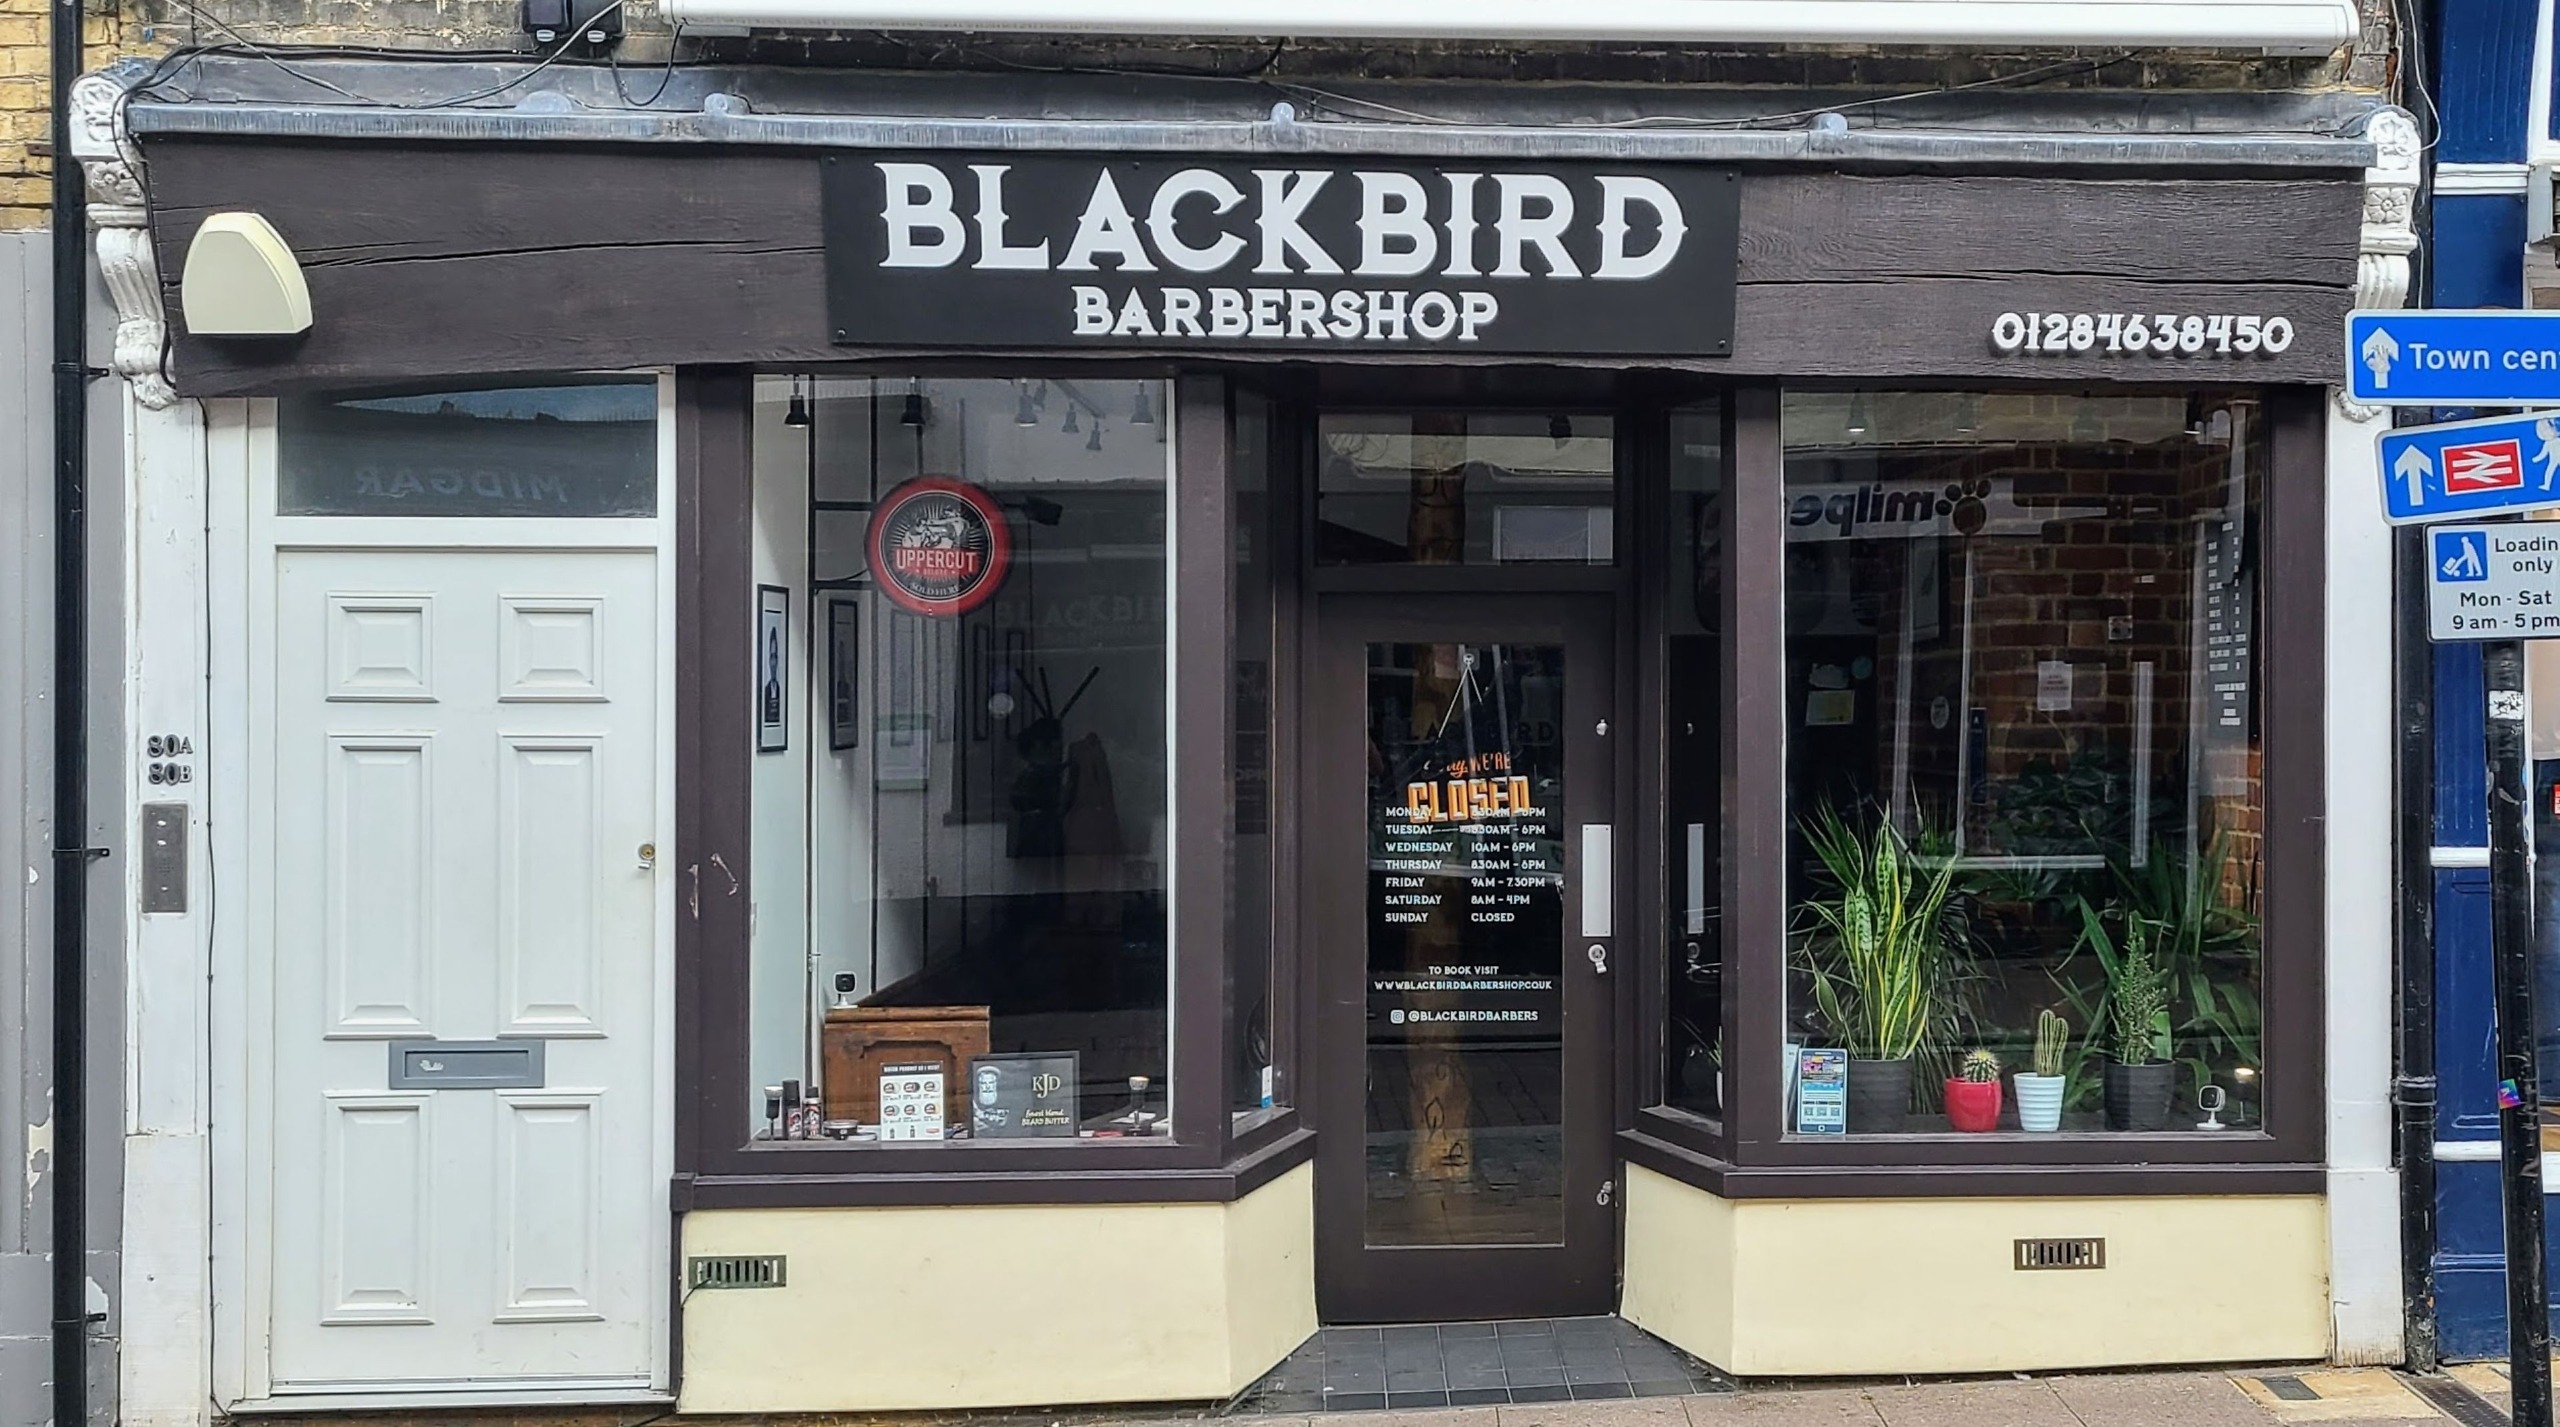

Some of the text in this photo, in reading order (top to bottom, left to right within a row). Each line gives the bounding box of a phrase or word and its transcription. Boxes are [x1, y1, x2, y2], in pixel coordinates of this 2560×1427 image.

[874, 162, 1689, 280] BLACKBIRD
[1071, 285, 1498, 341] BARBERSHOP
[1991, 312, 2294, 353] 01284638450
[2408, 343, 2560, 370] Town cen
[2495, 536, 2560, 553] Loadin
[896, 549, 977, 573] UPPERCUT
[2513, 557, 2552, 574] only
[2460, 592, 2501, 607] Mon
[2518, 590, 2552, 606] Sat
[2452, 615, 2464, 630] 9
[2469, 618, 2497, 629] am
[2515, 613, 2526, 628] 5
[2531, 616, 2560, 630] pm
[147, 734, 194, 758] 80A
[148, 762, 192, 786] 80B
[1408, 775, 1531, 823] CLOSED
[1386, 806, 1433, 817] MONDAY
[1385, 824, 1434, 835] TUESDAY
[1521, 824, 1546, 835] 6PM
[1385, 842, 1453, 852] WEDNESDAY
[1471, 842, 1500, 852] 10AM
[1512, 842, 1536, 852] 6PM
[1385, 860, 1442, 870] THURSDAY
[1521, 859, 1546, 870] 6PM
[1385, 877, 1425, 887] FRIDAY
[1471, 877, 1496, 887] 9AM
[1385, 895, 1442, 905] SATURDAY
[1471, 895, 1496, 905] 8AM
[1506, 895, 1531, 905] 4PM
[1385, 912, 1515, 923] SUNDAY CLOSED
[1428, 966, 1499, 975] TO BOOK VISIT
[1408, 1010, 1538, 1022] @BLACKBIRDBARBERS
[1032, 1073, 1061, 1098] KJD
